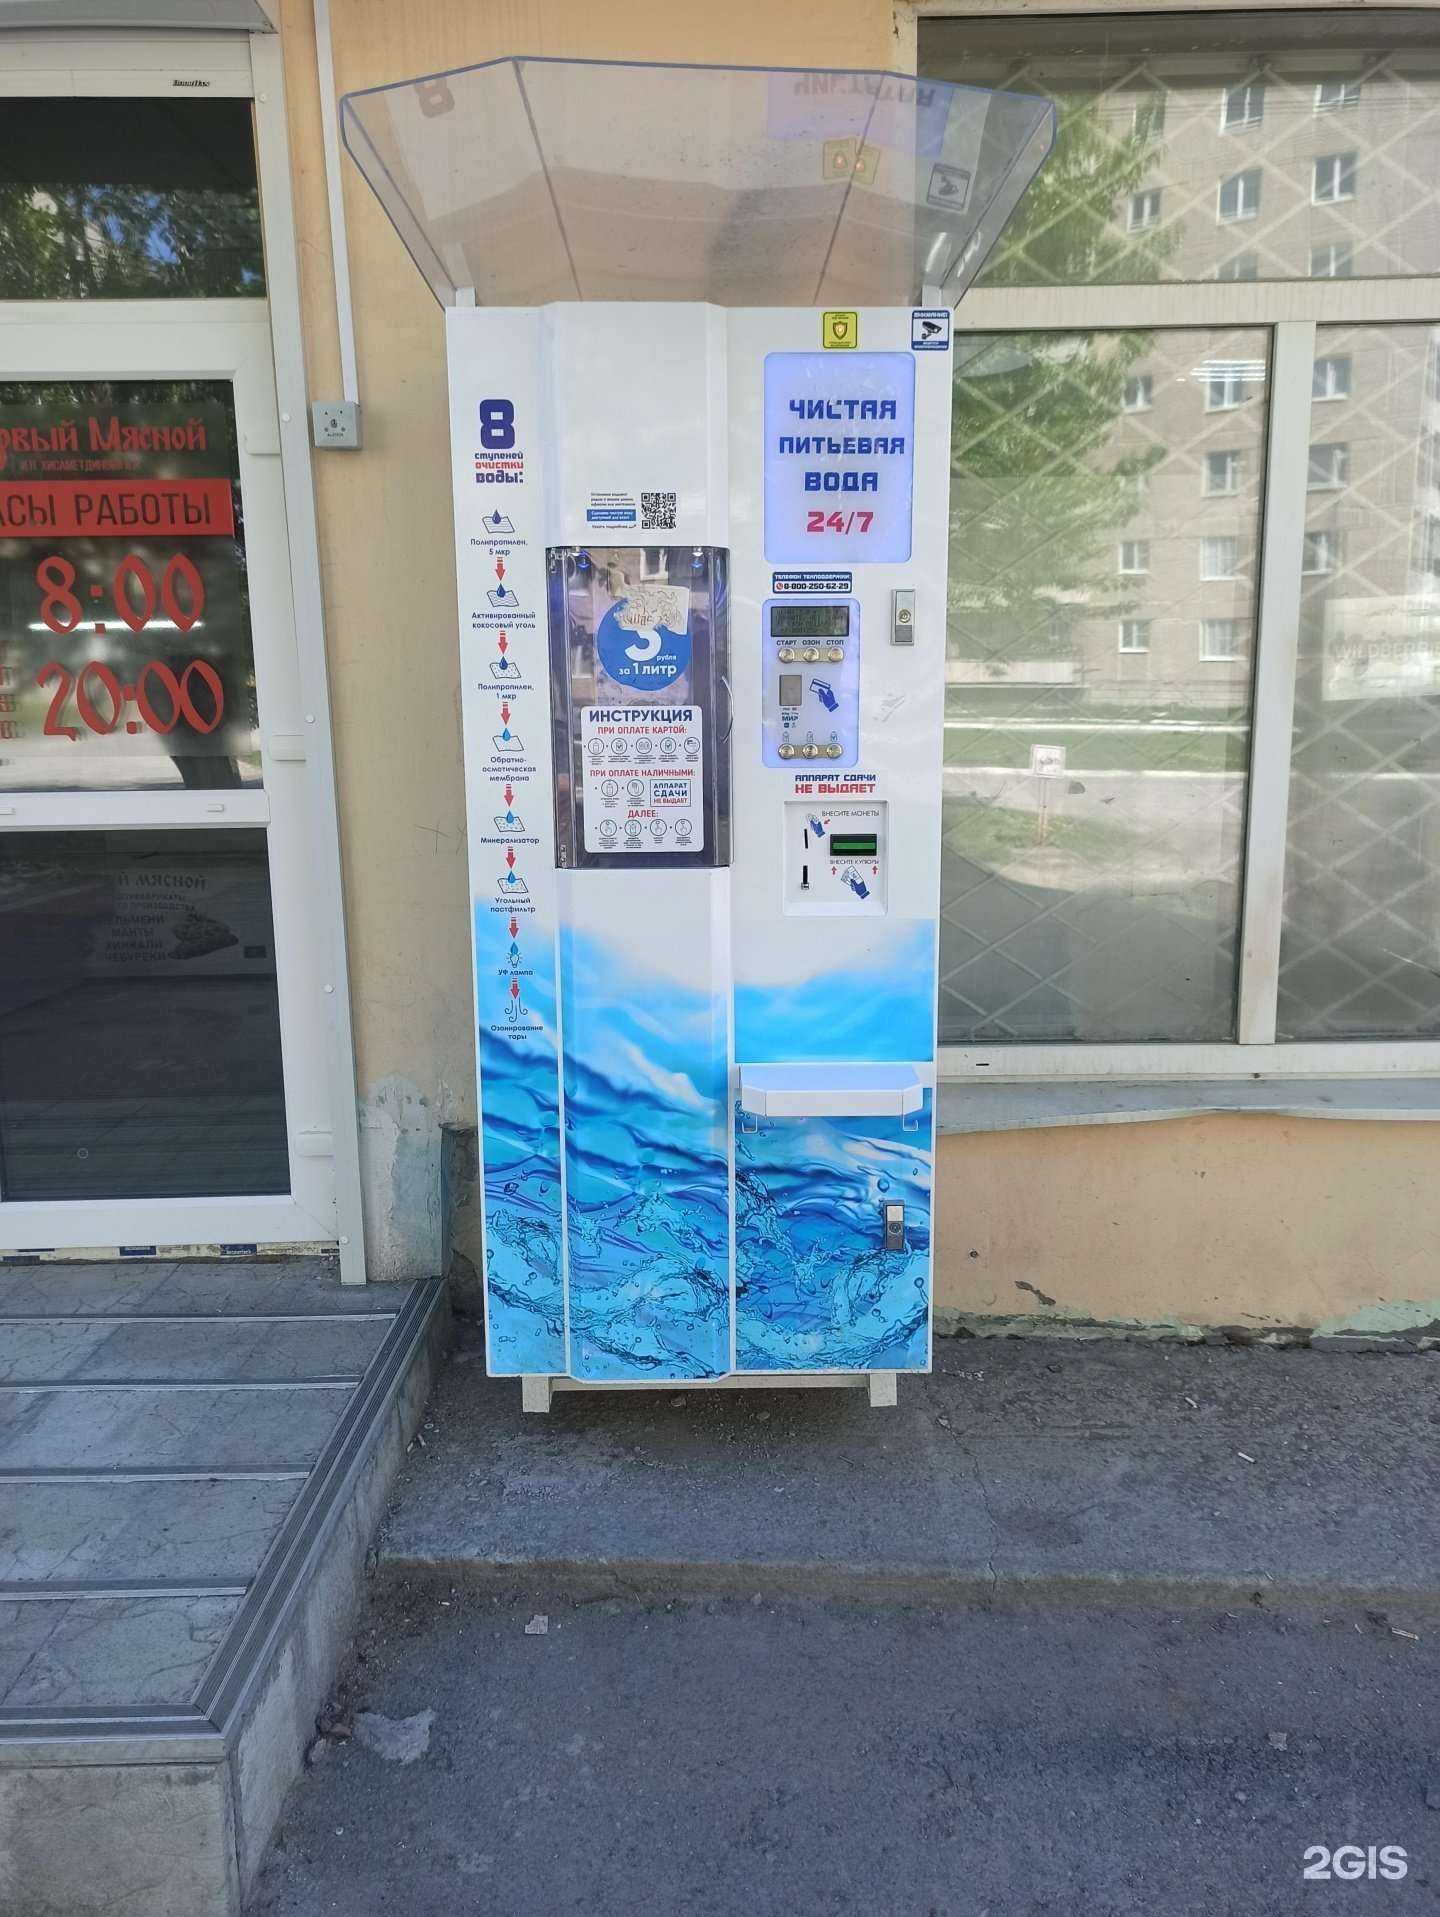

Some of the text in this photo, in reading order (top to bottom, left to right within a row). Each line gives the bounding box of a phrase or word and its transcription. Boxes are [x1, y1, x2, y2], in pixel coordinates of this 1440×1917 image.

[789, 399, 897, 420] ЧИСТАЯ
[479, 399, 515, 450] 8
[88, 416, 206, 451] Мясной
[779, 436, 905, 455] ПИТЬЕВАЯ
[474, 451, 524, 461] ступеней
[475, 461, 524, 469] очистки
[476, 470, 524, 483] воды:
[804, 471, 878, 492] ВОДА
[75, 493, 212, 526] РАБОТЫ
[806, 511, 874, 534] 24/7
[495, 549, 510, 557] мкр
[36, 553, 206, 634] 8:00
[472, 611, 536, 620] Активированный
[472, 621, 514, 629] кокосовый
[656, 654, 677, 662] рубля
[619, 662, 677, 676] за 1 литр
[38, 659, 225, 741] 20:00
[589, 709, 693, 723] ИНСТРУКЦИЯ
[598, 725, 687, 734] ПРИ ОПЛАТЕ КАРТОЙ:
[490, 756, 527, 765] Обратно-
[590, 768, 696, 777] ПРИ ОПЛАТЕ НАЛИЧНЫМИ:
[794, 774, 840, 782] АППАРАТ
[794, 783, 876, 793] НЕ ВЫДАЕТ
[628, 810, 659, 819] ДАЛЕЕ:
[480, 837, 540, 845] Минерализатор
[490, 1024, 544, 1032] Озонирование
